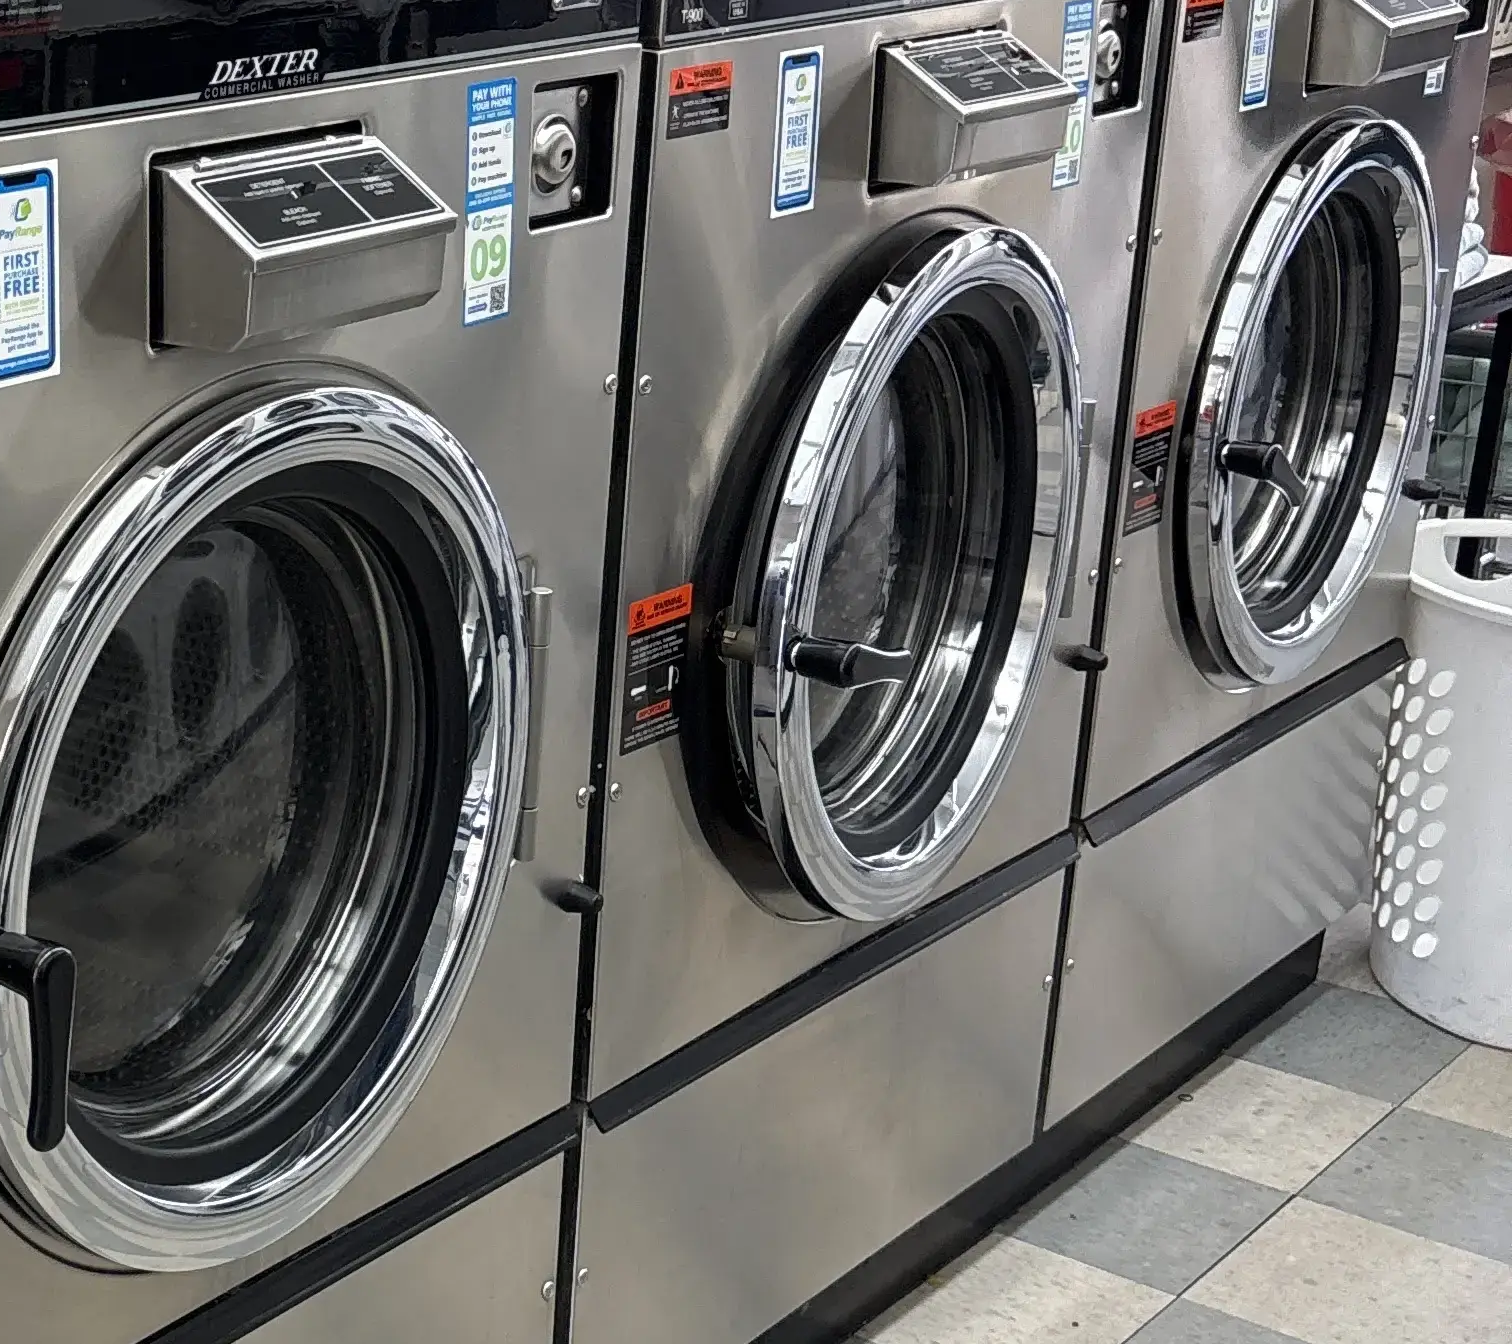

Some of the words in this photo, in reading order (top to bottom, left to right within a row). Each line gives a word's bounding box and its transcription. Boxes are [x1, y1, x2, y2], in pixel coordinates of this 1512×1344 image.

[208, 47, 320, 86] DEXTER
[3, 250, 40, 271] FIRST
[470, 234, 507, 283] 09
[3, 277, 40, 300] FREE
